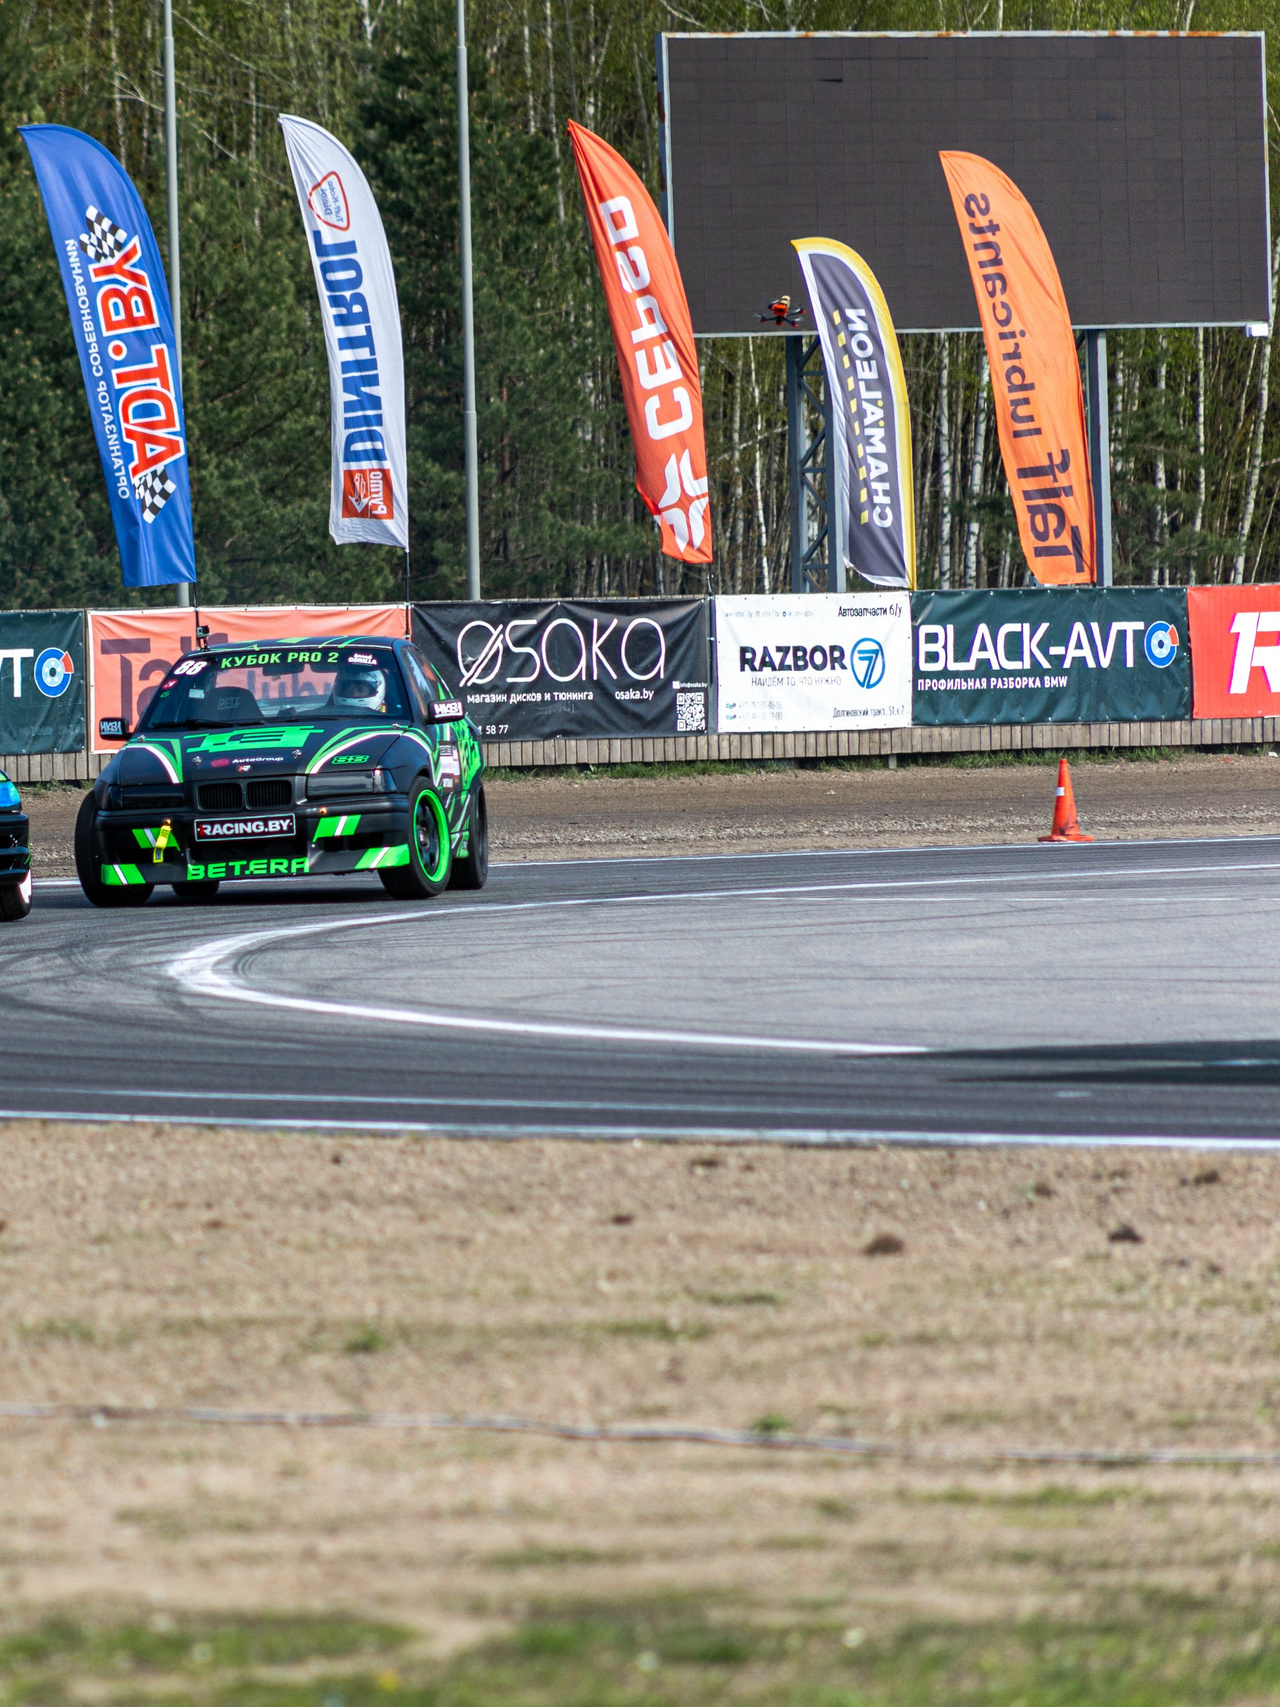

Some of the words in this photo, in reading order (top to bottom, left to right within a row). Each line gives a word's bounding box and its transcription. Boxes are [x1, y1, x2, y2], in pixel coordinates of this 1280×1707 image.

[837, 606, 888, 617] Автозапчасти
[889, 603, 903, 618] б/у
[221, 652, 283, 669] КУБОК
[287, 652, 322, 664] PRO
[326, 652, 340, 663] 2
[739, 645, 848, 672] RAZBOR
[173, 660, 208, 675] 88
[917, 677, 987, 691] ПРОФИЛЬНАЯ
[990, 676, 1041, 690] РАЗБОРКА
[1044, 676, 1068, 689] BMW
[467, 693, 508, 704] магазин
[509, 692, 543, 704] дисков
[544, 693, 551, 702] и
[552, 691, 594, 702] тюнинга
[615, 688, 655, 701] osaka.by
[485, 724, 497, 735] 58
[498, 724, 509, 734] 77
[232, 756, 284, 764] AutoGroup
[331, 754, 370, 765] 88
[198, 819, 291, 836] RACING.BY
